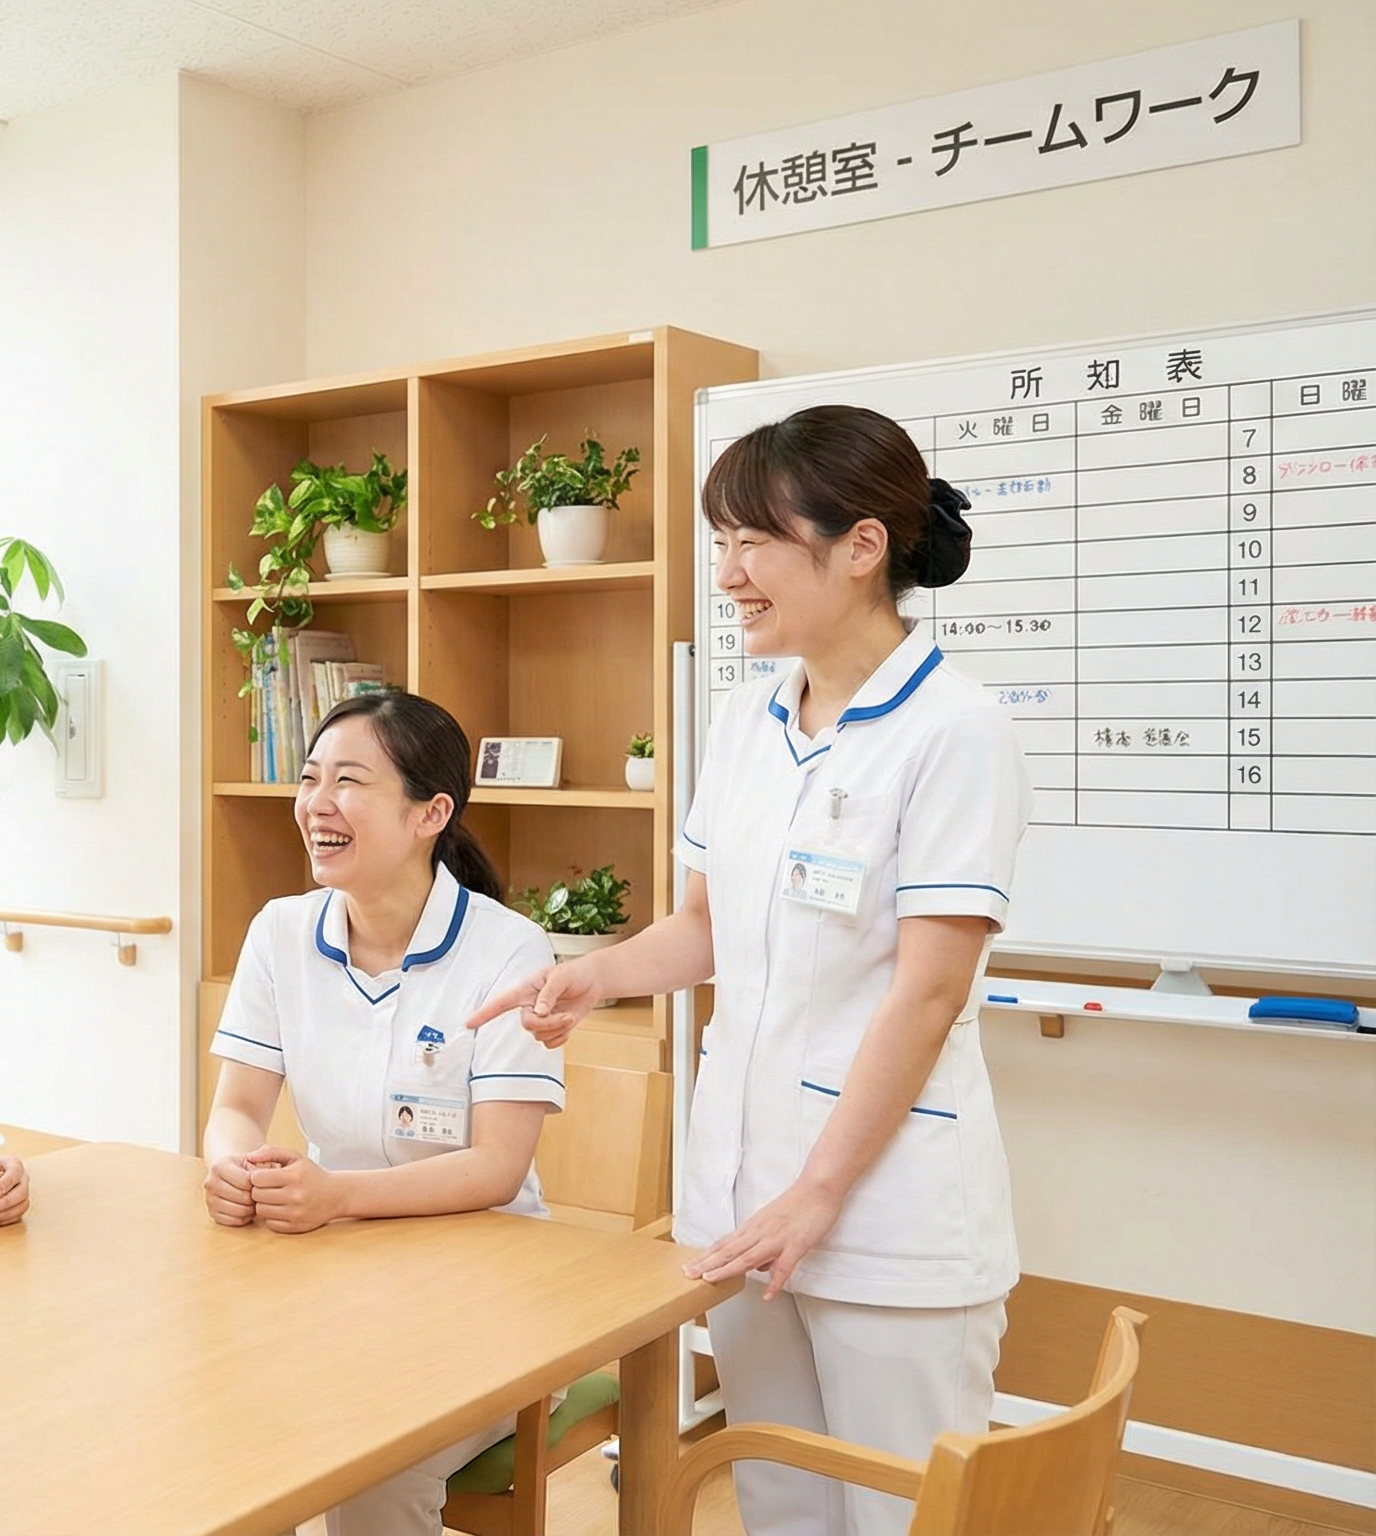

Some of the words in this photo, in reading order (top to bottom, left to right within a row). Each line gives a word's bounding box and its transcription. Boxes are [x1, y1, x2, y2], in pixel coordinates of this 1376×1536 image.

[732, 141, 880, 216] 休憩室
[931, 66, 1261, 178] チームワーク
[1242, 428, 1257, 448] 7
[1242, 465, 1257, 485] 8
[1242, 503, 1257, 522] 9
[1237, 539, 1262, 559] 10
[1237, 578, 1259, 596] 11
[717, 602, 736, 619] 10
[1237, 614, 1262, 634] 12
[717, 634, 736, 650] 19
[1237, 652, 1262, 673] 13
[717, 665, 735, 682] 13
[1237, 689, 1263, 710] 14
[1237, 727, 1262, 748] 15
[1237, 765, 1262, 786] 16
